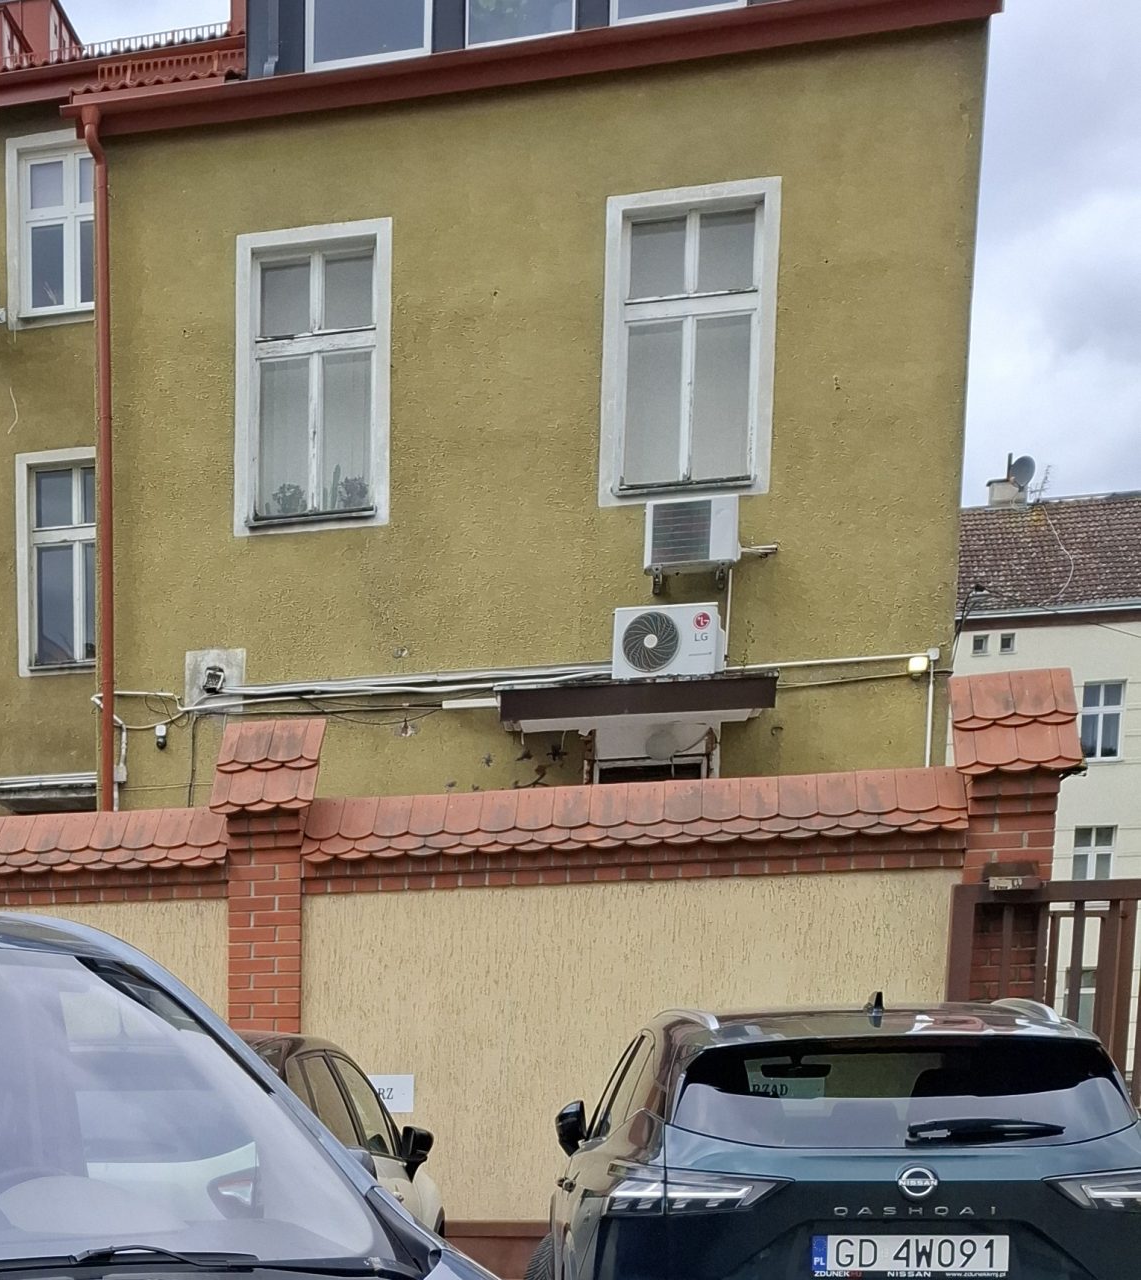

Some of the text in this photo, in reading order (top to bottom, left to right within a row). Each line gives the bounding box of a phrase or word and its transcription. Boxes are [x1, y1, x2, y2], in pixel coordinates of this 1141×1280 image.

[694, 632, 709, 642] LG
[377, 1087, 394, 1100] RZ
[897, 1178, 938, 1187] NISSAN
[833, 1205, 997, 1217] QASHQAI
[835, 1238, 995, 1268] GD 4W091
[813, 1256, 826, 1266] PL
[887, 1270, 932, 1278] NISSAN
